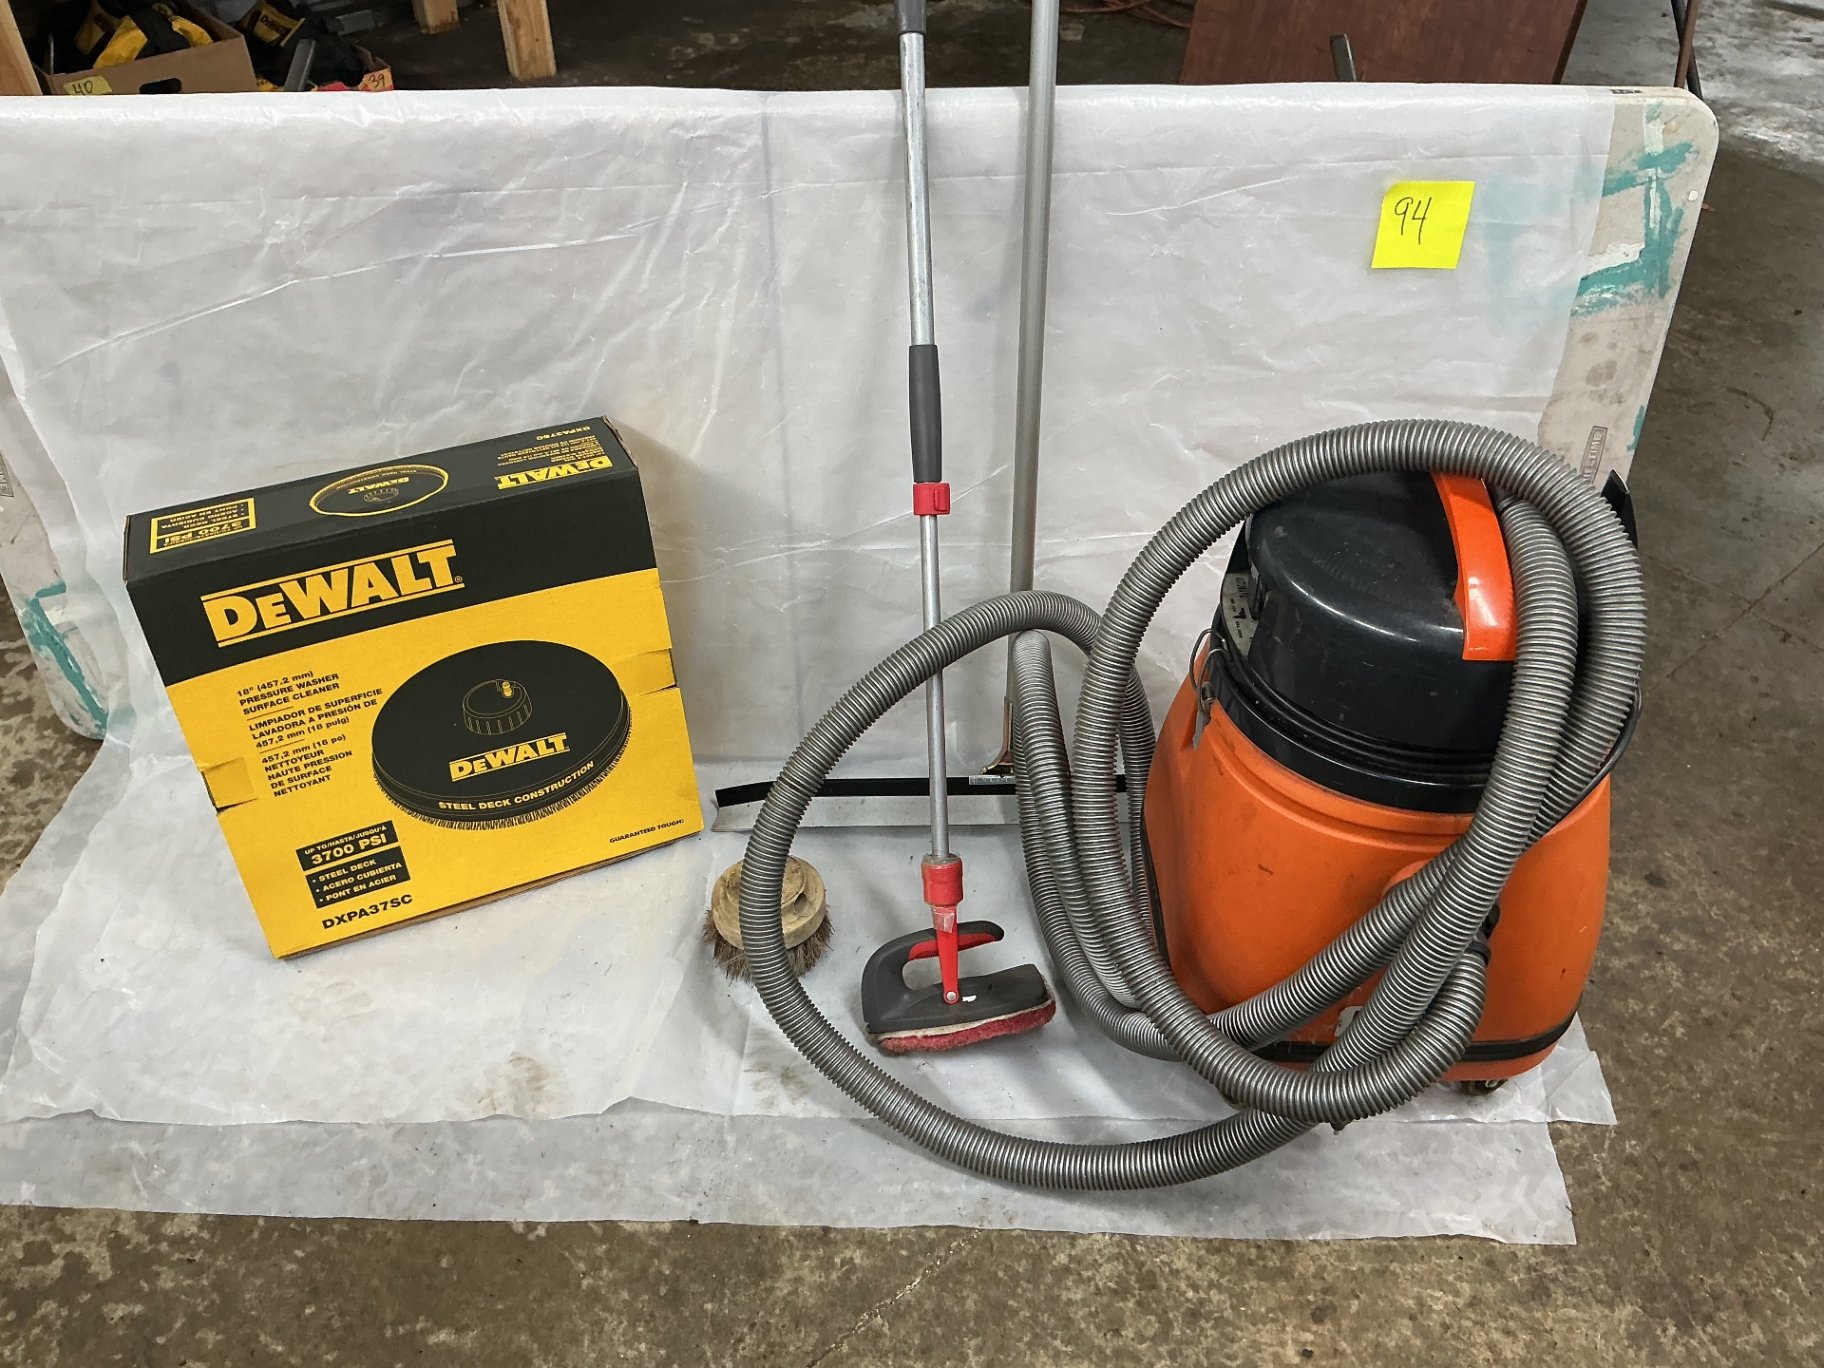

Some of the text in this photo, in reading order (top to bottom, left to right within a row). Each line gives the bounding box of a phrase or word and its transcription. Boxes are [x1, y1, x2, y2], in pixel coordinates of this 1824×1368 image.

[72, 80, 93, 95] 40
[368, 73, 386, 88] 39
[1394, 196, 1432, 246] 94
[496, 456, 613, 489] DEWALT
[202, 544, 457, 643] DEWALT
[239, 673, 340, 706] PRESSURE WASHER
[257, 677, 290, 692] (457.2
[292, 670, 314, 682] mm)
[243, 682, 340, 715] SURFACE CLEANER
[249, 688, 384, 731] LIMPIADOR DE SUPERFICIE
[252, 719, 307, 740] LAVADORA
[317, 703, 362, 721] PRESIÓN
[363, 698, 379, 708] DE
[256, 736, 285, 748] 457,2
[286, 729, 306, 740] mm
[261, 750, 291, 764] 457,2
[292, 744, 311, 756] mm
[331, 733, 347, 745] po)
[264, 749, 325, 773] NETTOYEUR
[267, 750, 353, 781] HAUTE PRESSION
[449, 734, 567, 781] DEWALT
[270, 765, 333, 790] DE SURFACE
[273, 774, 332, 797] NETTOYANT
[438, 760, 595, 811] STEEL DECK CONSTRUCTION
[304, 847, 316, 855] UP
[310, 833, 387, 865] 3700 PSI
[609, 827, 656, 844] GUARANTEED
[318, 859, 377, 882] STEEL DECK
[322, 862, 403, 892] ACERO CUBIERTA
[325, 874, 397, 901] PONT EN ACIER
[321, 894, 413, 930] DXPA37SC
